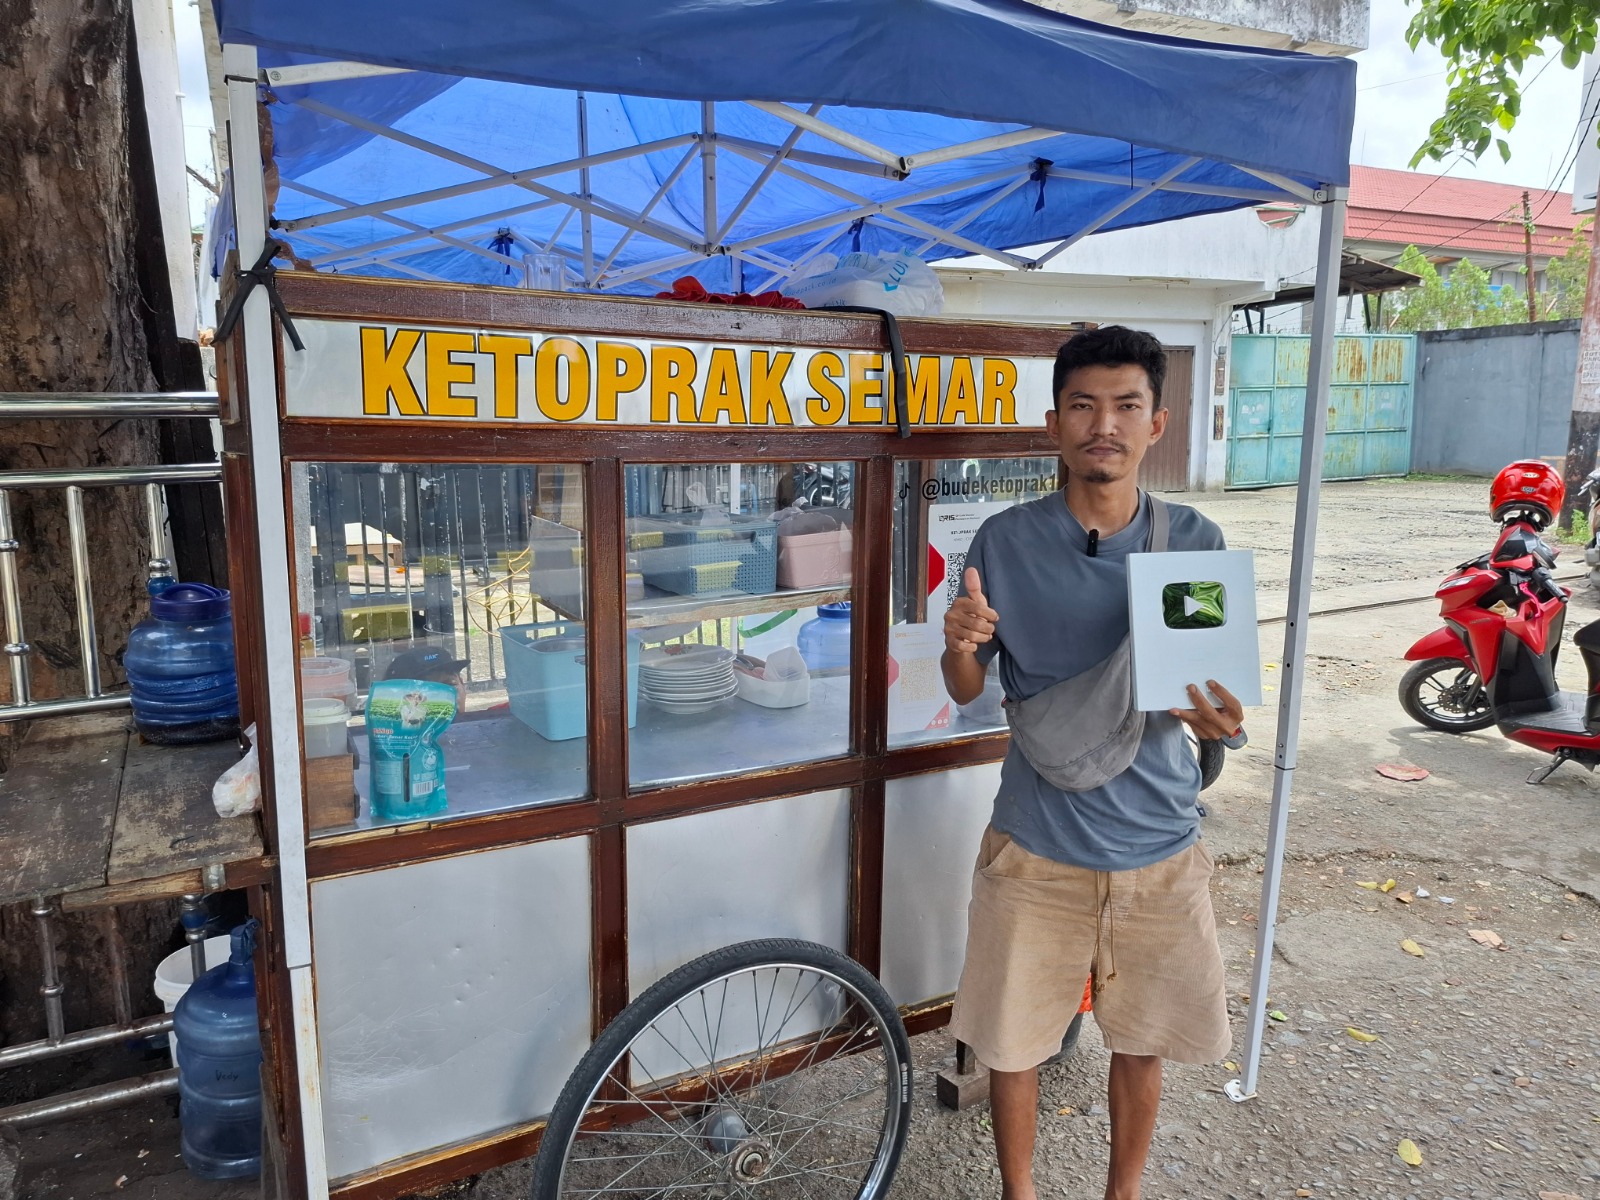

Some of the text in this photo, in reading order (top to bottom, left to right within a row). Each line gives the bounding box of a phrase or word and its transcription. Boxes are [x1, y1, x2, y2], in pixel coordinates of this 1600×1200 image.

[359, 326, 1019, 426] KETOPRAK SEMAR
[922, 474, 1056, 500] @budeketoprak1
